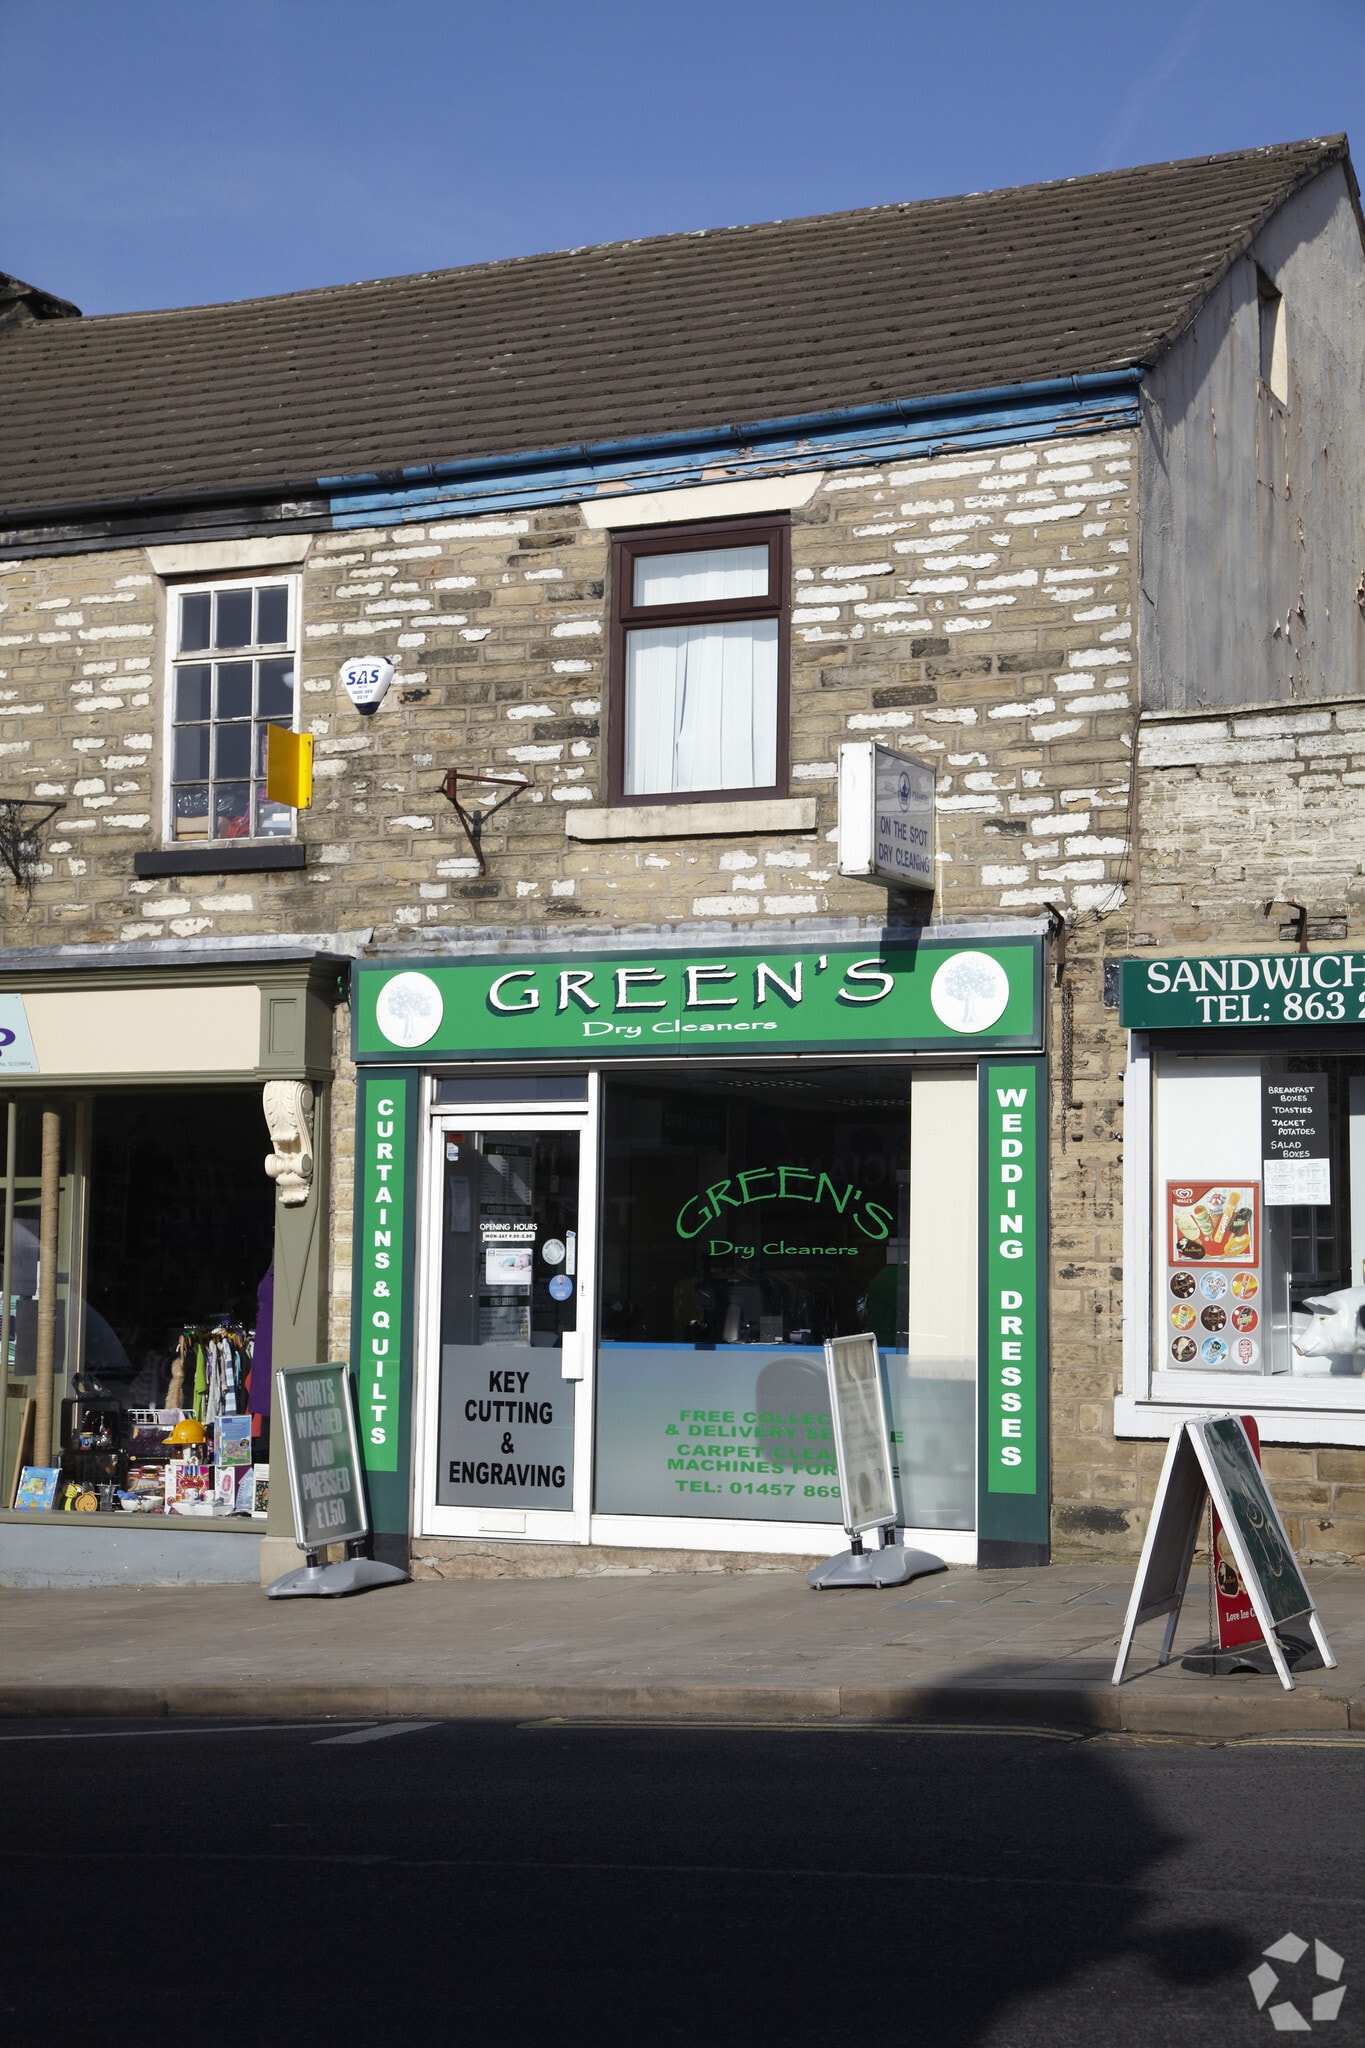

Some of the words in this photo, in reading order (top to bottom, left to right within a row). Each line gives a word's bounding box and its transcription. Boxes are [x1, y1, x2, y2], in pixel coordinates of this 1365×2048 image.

[346, 669, 379, 685] SAS
[880, 816, 891, 835] ON
[894, 820, 907, 841] THE
[910, 826, 928, 847] SPOT
[879, 842, 893, 863] DRY
[896, 848, 930, 874] CLEANING
[489, 955, 895, 1011] GREEN'S
[1147, 955, 1365, 994] SANDWICH
[1195, 994, 1270, 1023] TEL:
[1283, 991, 1346, 1021] 863
[582, 1022, 642, 1038] Dry
[652, 1019, 778, 1034] Cleaners
[1268, 1086, 1315, 1095] BREAKFAST
[1272, 1106, 1313, 1114] TOASTIES
[1272, 1119, 1306, 1127] JACKET
[1278, 1128, 1316, 1136] POTATOES
[1271, 1140, 1302, 1150] SALAD
[1283, 1150, 1310, 1158] BOXES
[374, 1099, 394, 1269] CURTAINS
[996, 1088, 1028, 1259] WEDDING
[676, 1166, 894, 1239] GREEN'S
[479, 1223, 511, 1231] OPENING
[513, 1223, 538, 1231] HOURS
[709, 1240, 755, 1259] Dry
[763, 1240, 859, 1255] Cleaners
[373, 1281, 390, 1298] &
[370, 1310, 391, 1445] QUILTS
[489, 1371, 530, 1393] KEY
[1000, 1290, 1024, 1466] DRESSES
[296, 1379, 337, 1409] SHIRTS
[465, 1399, 553, 1424] CUTTING
[679, 1410, 735, 1423] FREE
[742, 1411, 831, 1426] COLLEC
[294, 1408, 343, 1440] WASHED
[664, 1423, 680, 1436] &
[688, 1424, 796, 1440] DELIVERY
[310, 1439, 335, 1468] AND
[501, 1432, 515, 1454] &
[676, 1444, 763, 1459] CARPET
[772, 1446, 838, 1461] CLEA
[449, 1461, 565, 1488] ENGRAVING
[667, 1458, 785, 1475] MACHINES
[792, 1463, 838, 1476] FOR
[301, 1467, 351, 1500] PRESSED
[675, 1480, 723, 1494] TEL:
[729, 1482, 797, 1497] 01457
[316, 1499, 347, 1529] £1.50
[1226, 1612, 1240, 1622] Love
[1241, 1609, 1249, 1620] Ice
